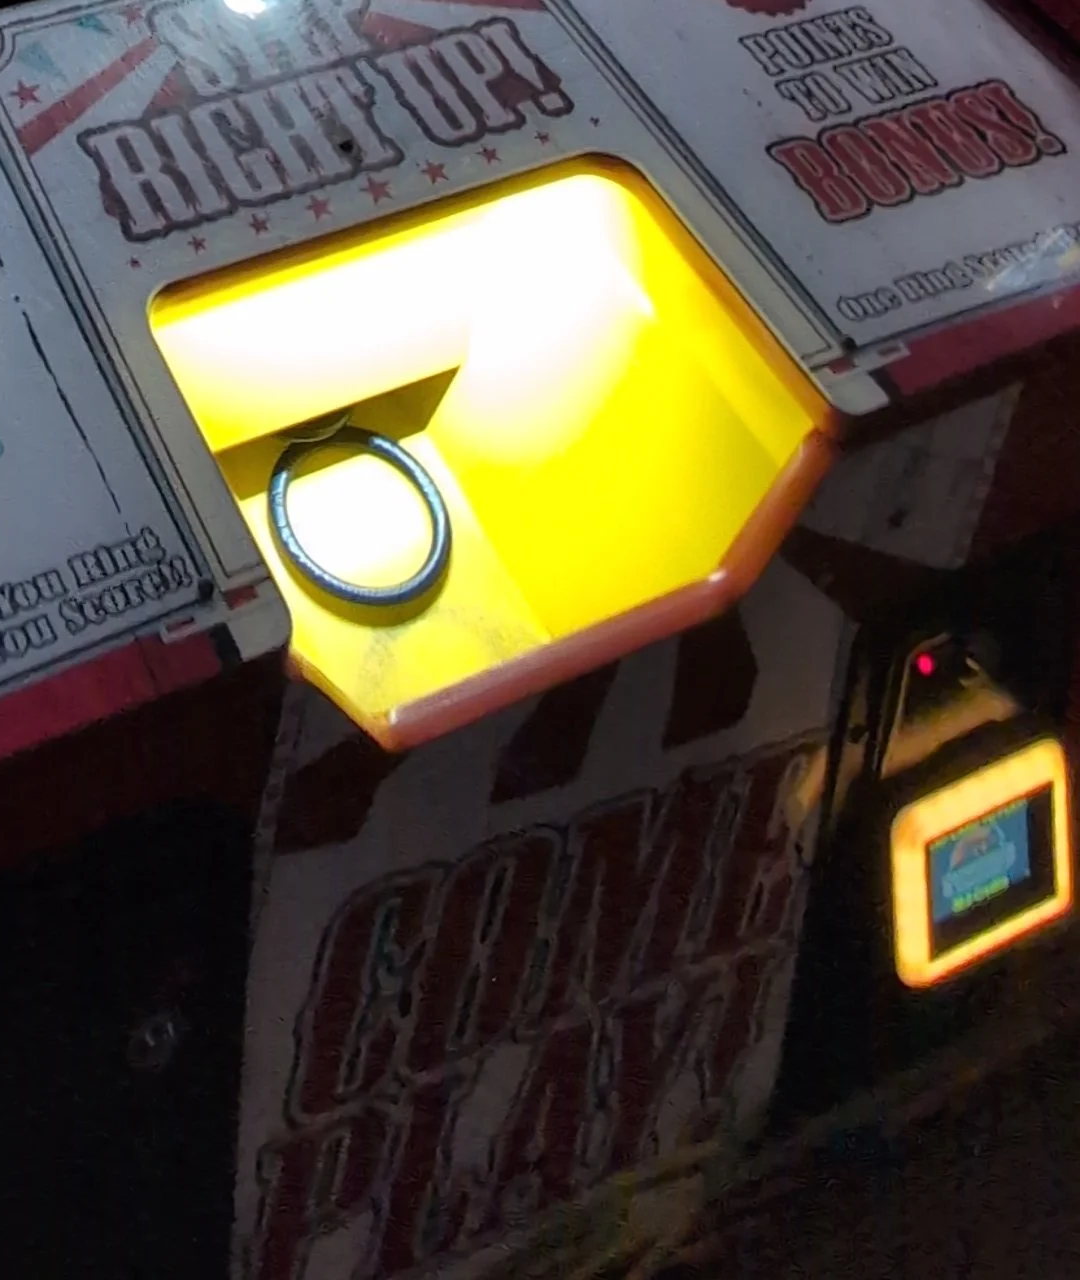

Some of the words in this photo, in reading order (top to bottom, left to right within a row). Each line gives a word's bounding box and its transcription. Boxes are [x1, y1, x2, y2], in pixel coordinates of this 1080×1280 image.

[739, 5, 894, 76] POINTS
[775, 68, 852, 122] TO
[833, 46, 939, 104] WIN
[79, 56, 403, 240] RIGHT
[357, 17, 575, 147] UP!
[766, 78, 1067, 223] BONUS!
[836, 286, 903, 322] One
[892, 259, 974, 304] Ring
[68, 525, 167, 589] Ring
